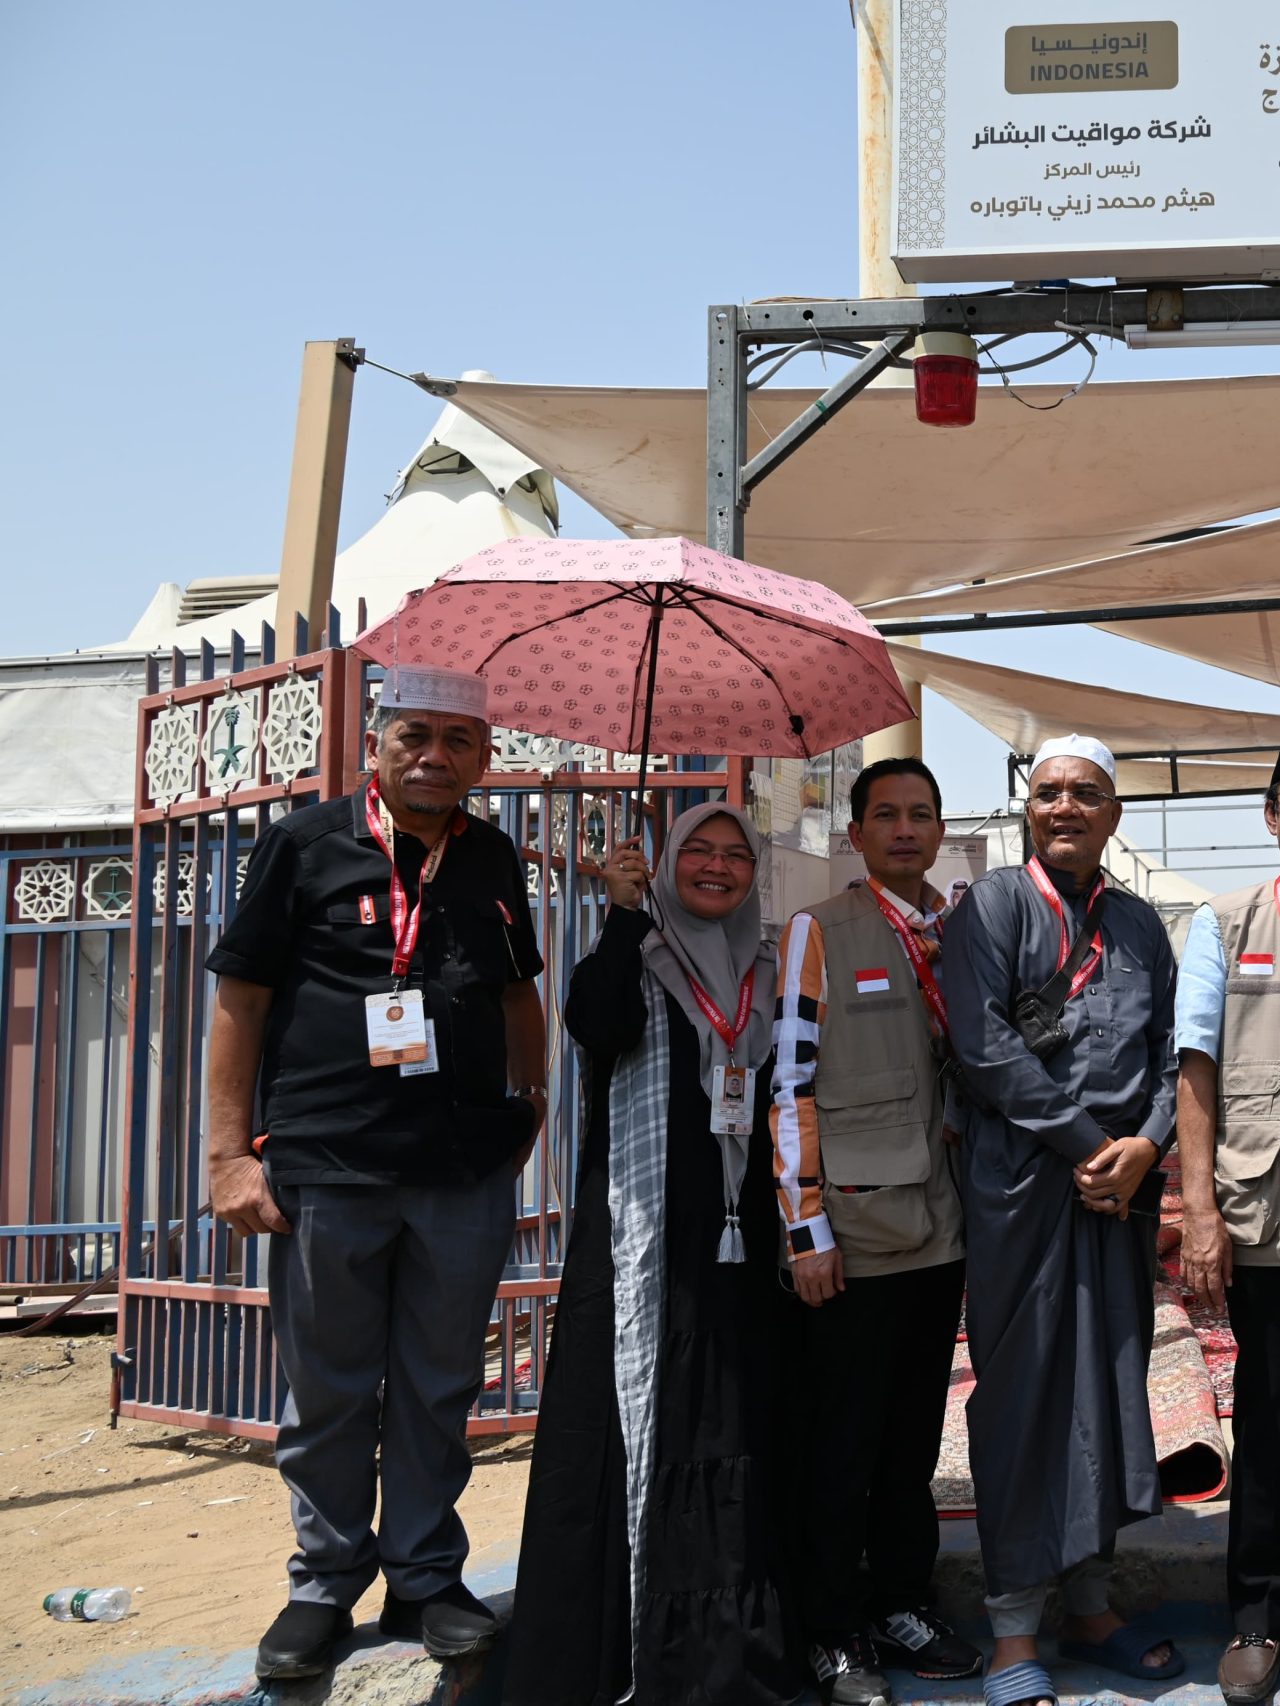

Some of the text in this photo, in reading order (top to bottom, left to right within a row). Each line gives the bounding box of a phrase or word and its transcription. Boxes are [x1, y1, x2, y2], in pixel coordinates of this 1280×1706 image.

[1031, 32, 1148, 56] إندونيسيا
[1030, 61, 1149, 82] INDONESIA
[972, 115, 1212, 150] شركة مواقيت البشائر
[1043, 160, 1141, 180] رئيس المركز
[970, 188, 1216, 221] هيثم محمد زيني باتوباره
